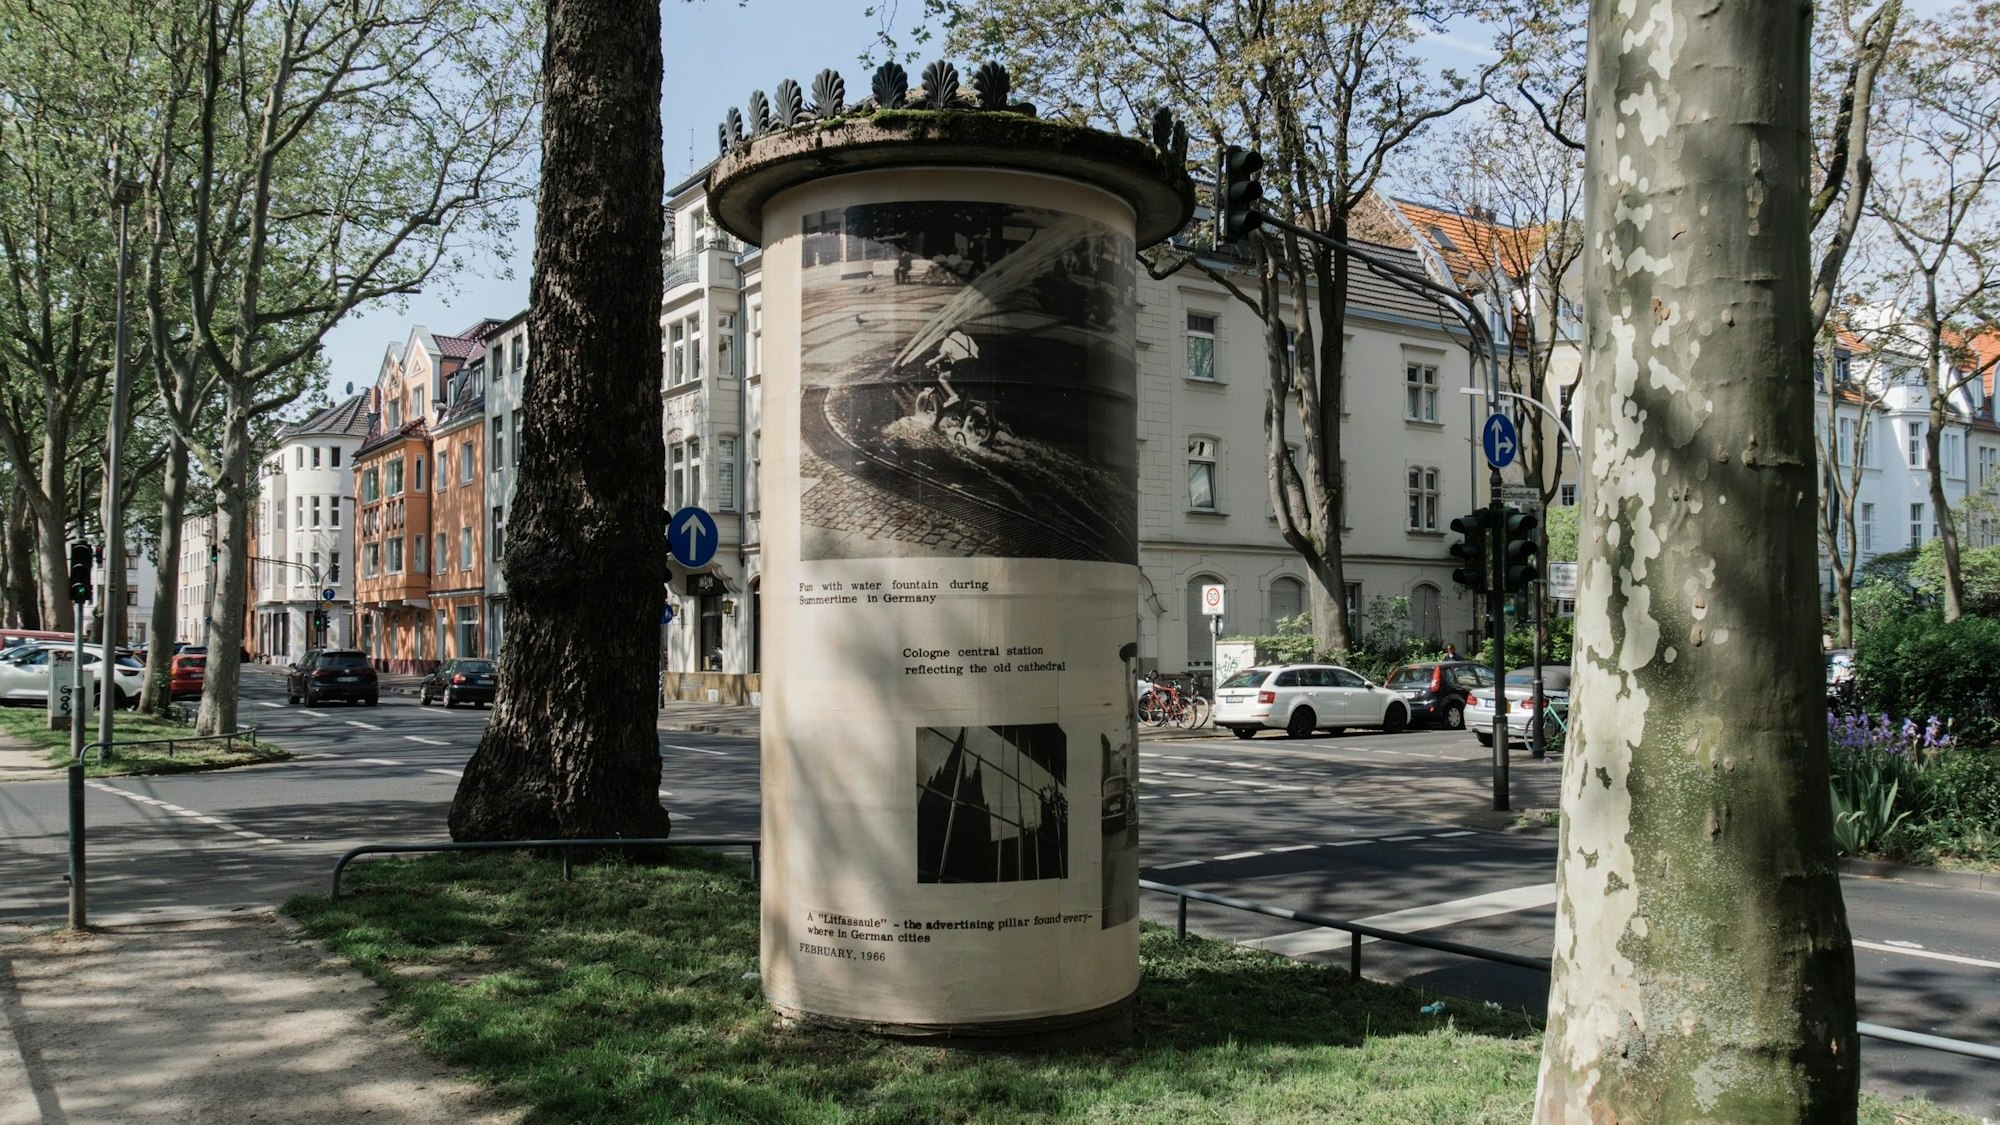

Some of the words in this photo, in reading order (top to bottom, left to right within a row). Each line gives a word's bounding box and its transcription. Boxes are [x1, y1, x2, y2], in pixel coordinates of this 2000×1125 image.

[1502, 489, 1538, 499] Eichendorffstr.
[799, 582, 813, 592] Fun
[822, 581, 843, 591] with
[851, 581, 882, 590] water
[892, 580, 939, 590] fountain
[949, 579, 989, 592] during
[799, 594, 858, 605] Summertime
[867, 593, 878, 603] in
[883, 593, 937, 604] Germany
[1209, 592, 1217, 601] 30
[902, 647, 950, 660] Cologne
[957, 646, 1000, 657] central
[1006, 645, 1044, 656] station
[904, 663, 964, 676] reflecting
[969, 663, 988, 673] the
[993, 662, 1012, 673] old
[1017, 661, 1066, 672] cathedral
[807, 912, 814, 921] A
[903, 919, 922, 930] the
[925, 919, 995, 931] advertising
[997, 917, 1030, 930] pillar
[1033, 912, 1062, 925] found
[1063, 912, 1093, 924] every-
[807, 925, 834, 937] where
[837, 928, 847, 938] in
[850, 929, 894, 942] German
[897, 932, 931, 943] cities
[799, 942, 857, 960] FEBRUARY,
[861, 951, 886, 961] 1966
